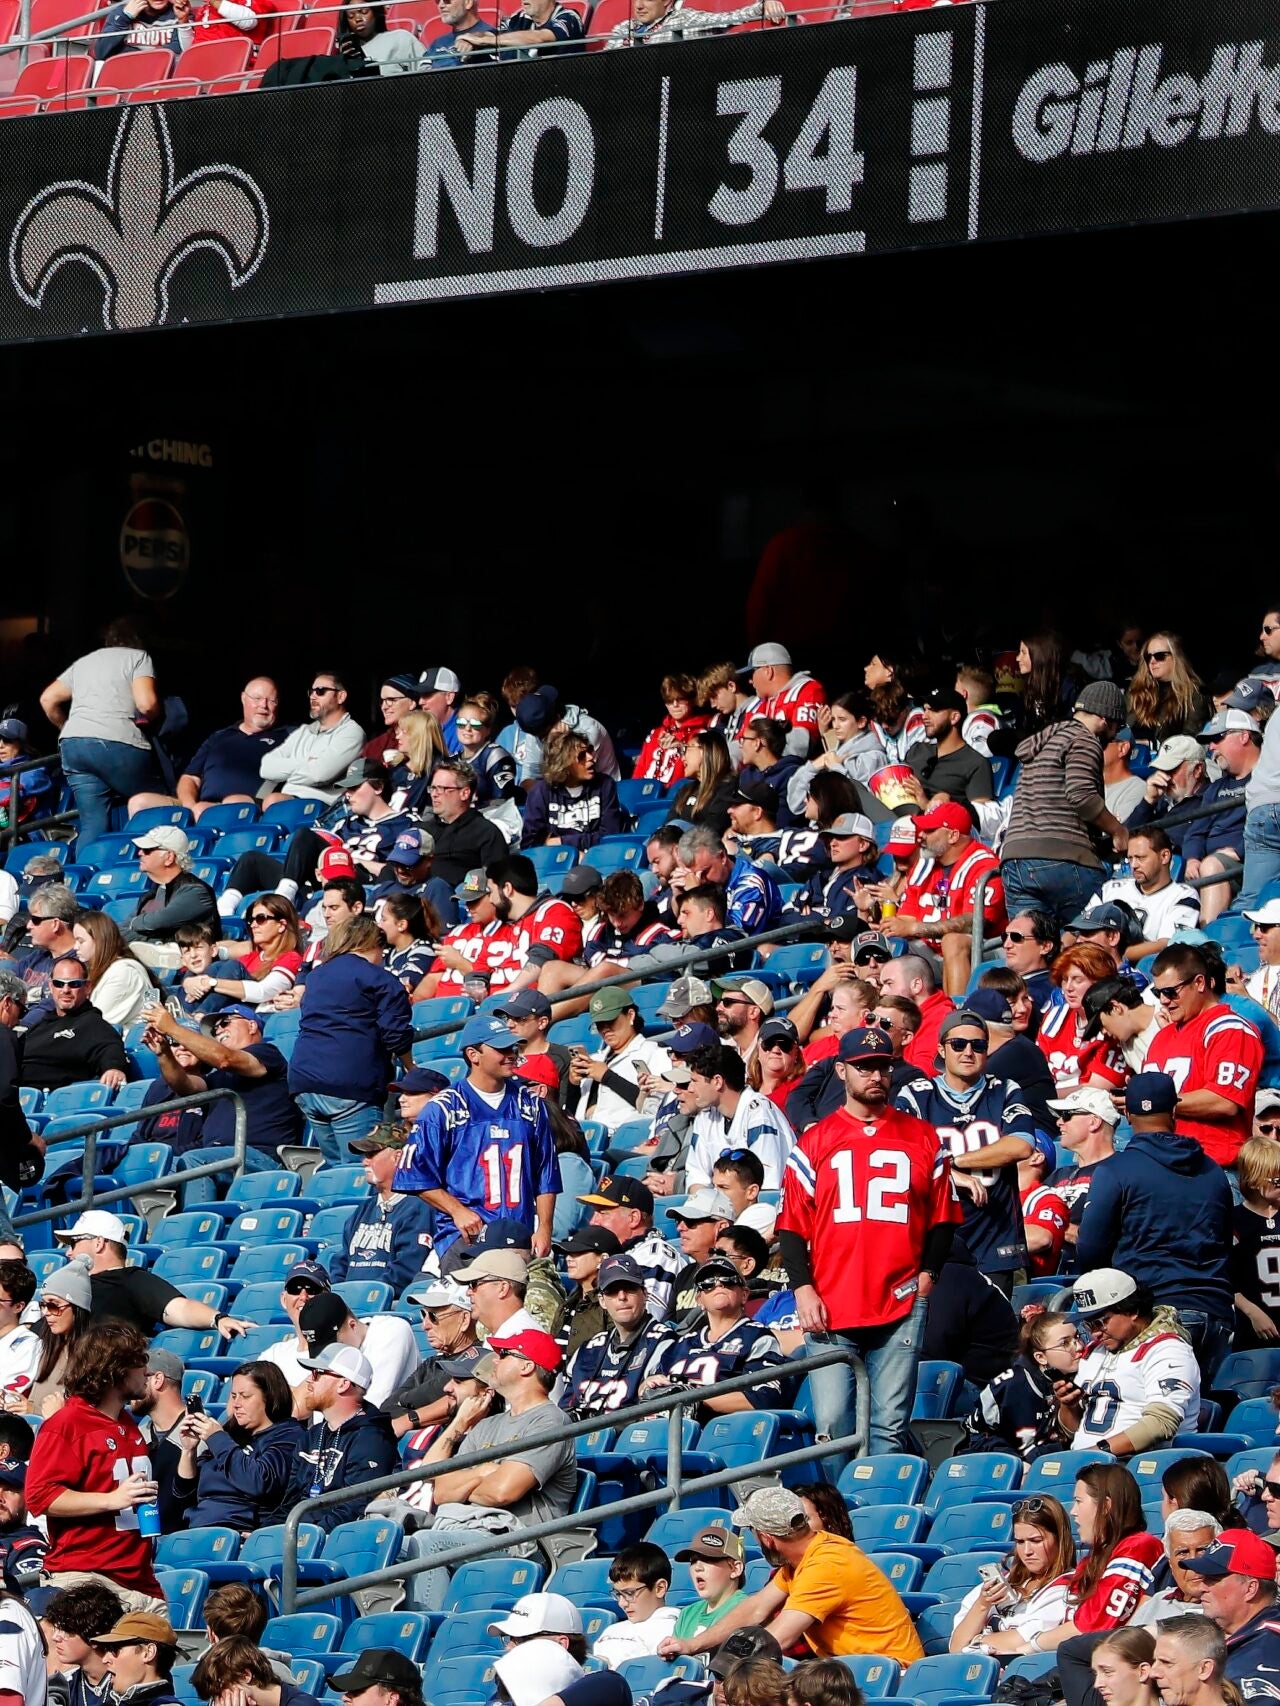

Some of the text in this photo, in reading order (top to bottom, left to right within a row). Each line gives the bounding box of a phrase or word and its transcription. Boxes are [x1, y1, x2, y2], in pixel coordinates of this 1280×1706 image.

[413, 97, 595, 259] NO
[708, 66, 865, 226] 34
[539, 926, 565, 945] 23
[1217, 1061, 1250, 1089] 87
[480, 1143, 525, 1209] 11
[830, 1148, 911, 1224] 12
